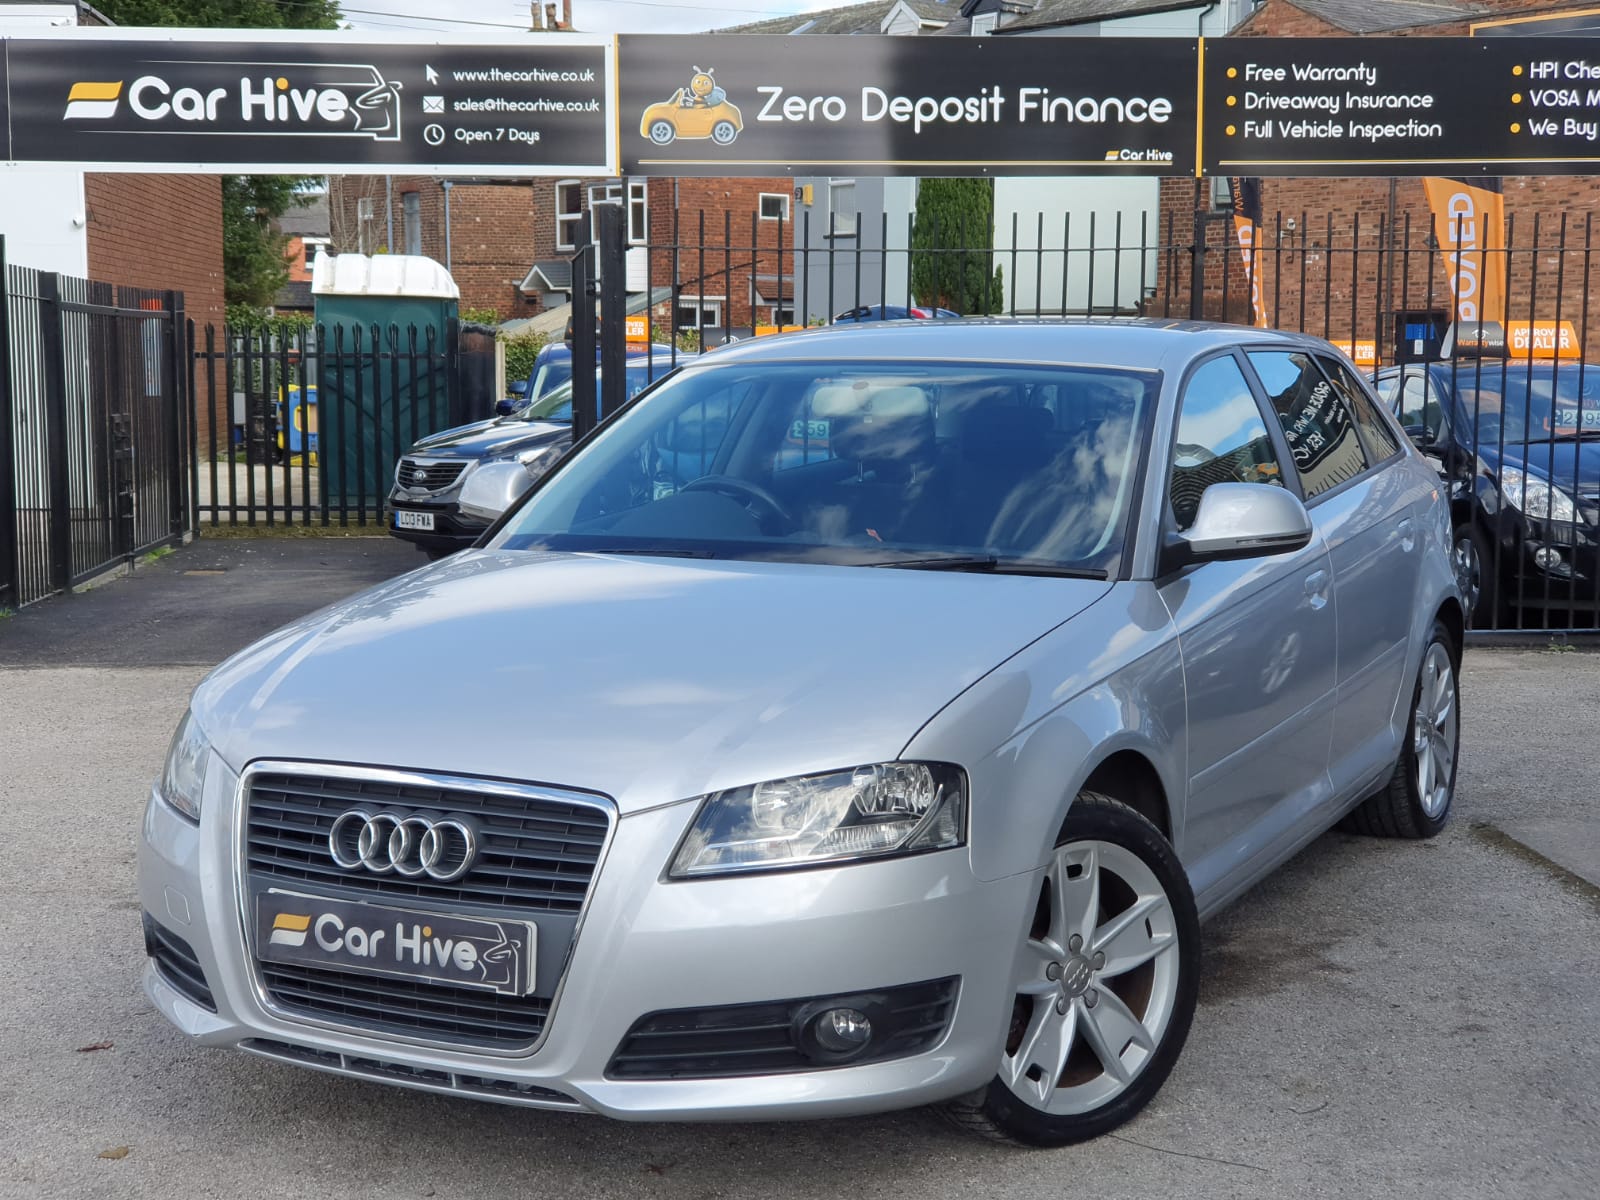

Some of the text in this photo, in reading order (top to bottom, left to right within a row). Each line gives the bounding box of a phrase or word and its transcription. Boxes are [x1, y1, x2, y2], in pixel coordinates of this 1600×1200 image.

[453, 68, 595, 82] www.thecarhive.co.uk
[1245, 62, 1377, 84] Free Warranty
[1530, 61, 1600, 79] HPI Che
[128, 75, 349, 121] Car Hive
[454, 98, 600, 112] sales@thecarhive.co.uk
[1245, 92, 1434, 114] Driveaway Insurance
[1529, 89, 1580, 107] VOSA
[756, 86, 1172, 133] Zero Deposit Finance
[454, 128, 540, 145] Open 7 Days
[1244, 119, 1442, 142] Full Vehicle Inspection
[1528, 118, 1597, 141] We Buy
[1120, 148, 1173, 161] Car Hive
[1514, 328, 1569, 337] APROVD
[1457, 339, 1504, 349] Warratywise
[314, 913, 477, 971] Car Hive
